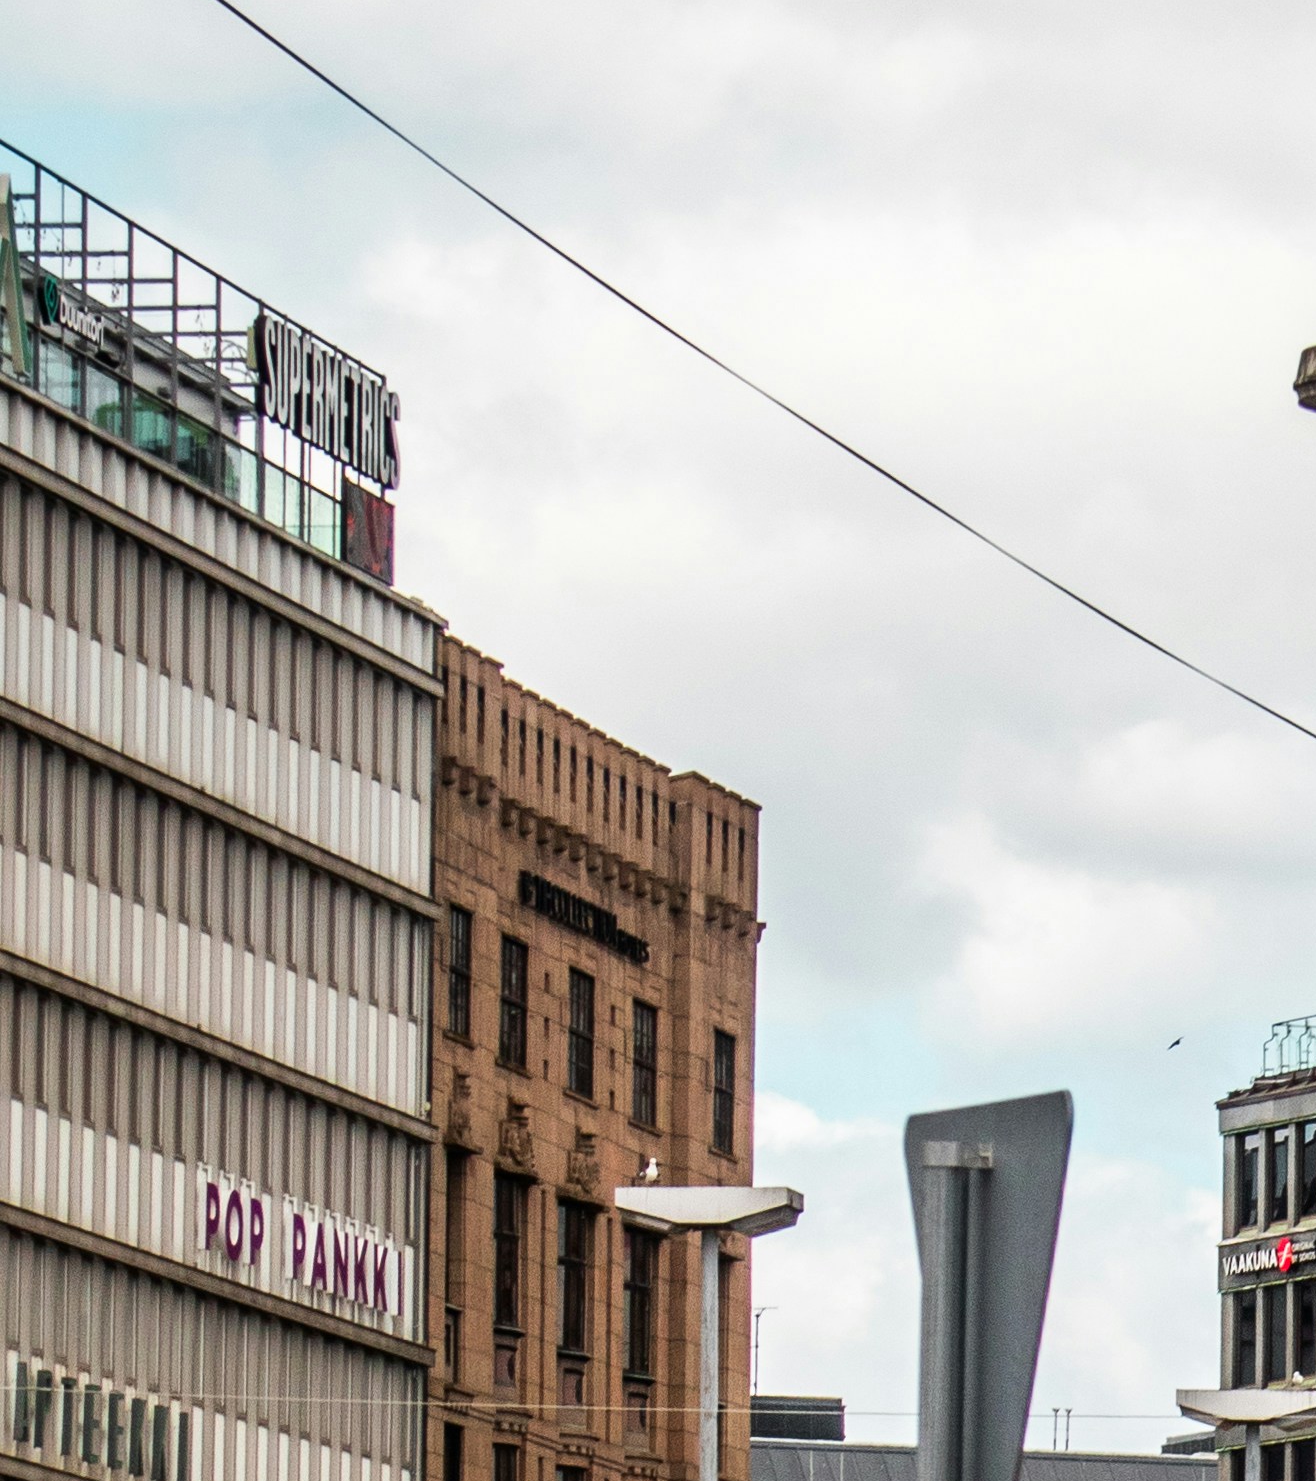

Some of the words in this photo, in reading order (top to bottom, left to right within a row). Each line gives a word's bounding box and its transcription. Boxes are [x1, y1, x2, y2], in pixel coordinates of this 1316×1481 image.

[262, 316, 401, 490] SUPERMETRICS
[205, 1182, 265, 1266] POP
[292, 1213, 402, 1317] PANKKI
[1222, 1248, 1278, 1277] VAAKUNA
